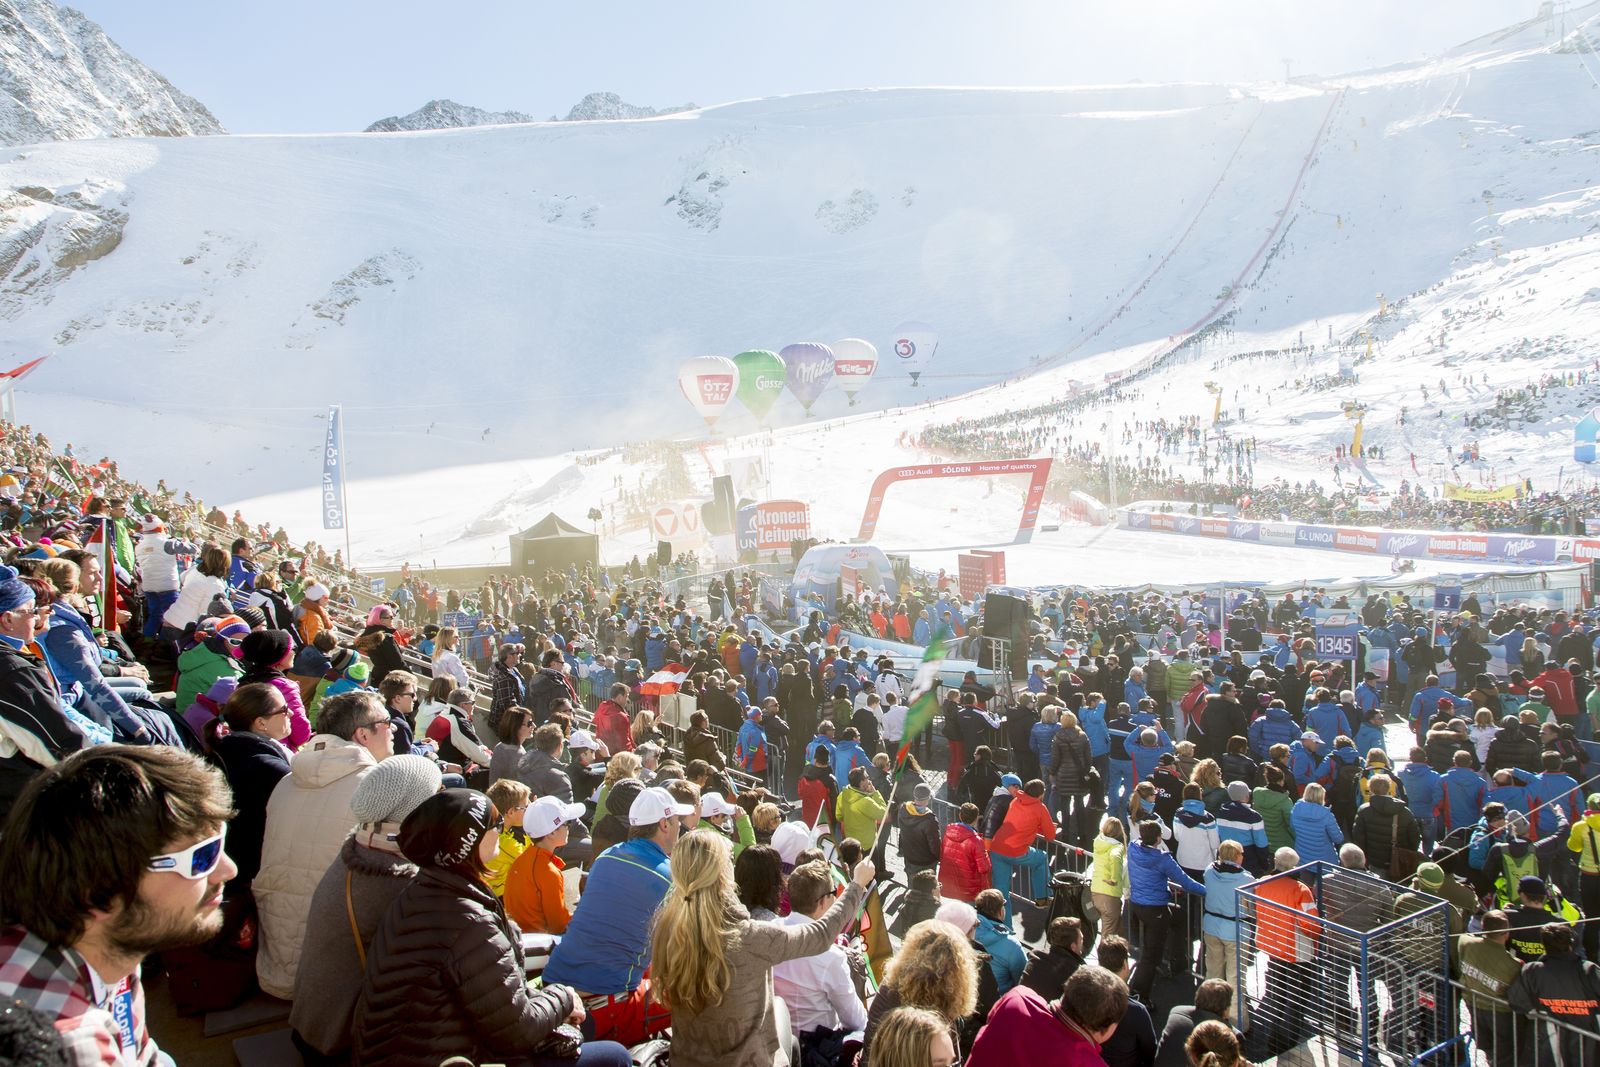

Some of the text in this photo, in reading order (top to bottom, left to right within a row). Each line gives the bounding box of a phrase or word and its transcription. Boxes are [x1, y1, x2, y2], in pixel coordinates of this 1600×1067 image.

[796, 357, 834, 384] Milka
[703, 379, 730, 392] ÖTZ
[704, 393, 725, 401] TAL
[941, 465, 971, 474] SÖLDEN
[979, 464, 999, 472] Home
[1010, 463, 1038, 471] quattro
[757, 510, 805, 525] Kronen
[758, 526, 806, 544] Zeitung
[1309, 532, 1334, 543] UNIQA
[1387, 534, 1418, 554] Milka
[1430, 536, 1487, 553] Kronen Zeitung
[1503, 539, 1537, 556] Milka
[1443, 595, 1451, 607] 5
[1318, 637, 1352, 654] 1345
[442, 827, 479, 867] Tiroler
[1459, 960, 1499, 992] EUERWEHR
[1538, 997, 1599, 1007] FEUERWEHR
[115, 995, 134, 1048] SÖLDEN
